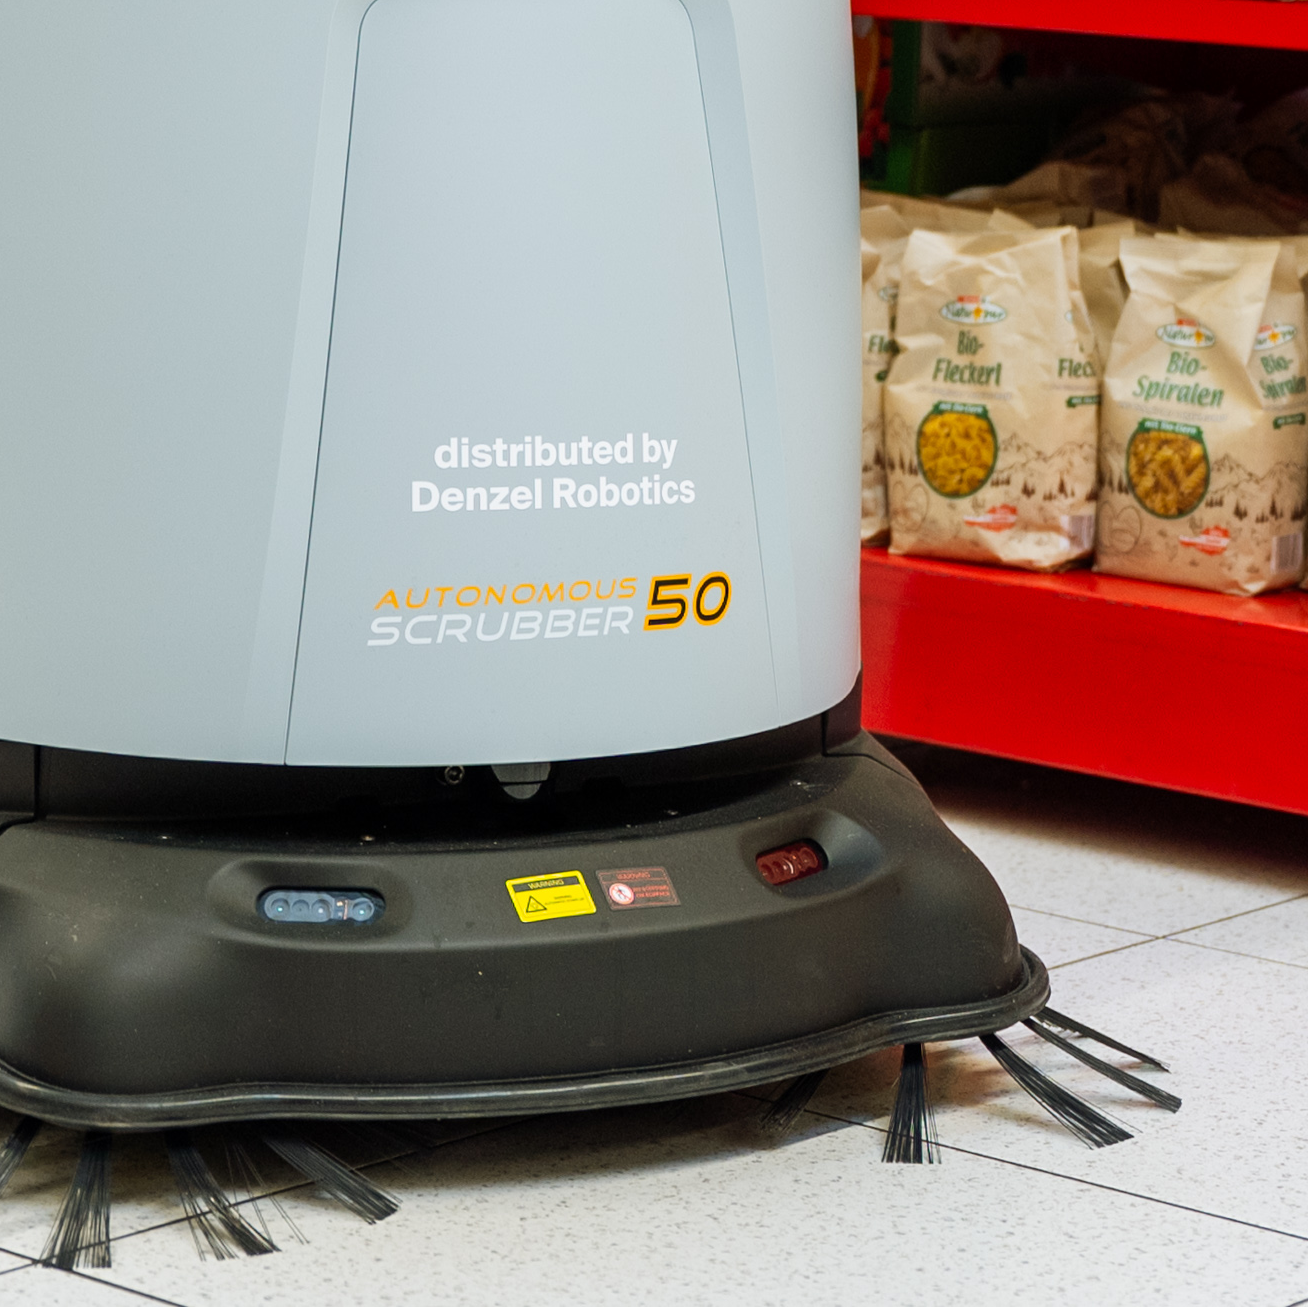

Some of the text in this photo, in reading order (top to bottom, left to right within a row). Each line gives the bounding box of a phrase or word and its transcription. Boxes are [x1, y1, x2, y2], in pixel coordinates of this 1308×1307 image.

[956, 329, 984, 356] Bio-
[932, 357, 1003, 386] Fleckerl
[1166, 350, 1208, 376] Bio-
[1132, 373, 1225, 408] Spiralen
[434, 432, 679, 470] distributed by
[411, 474, 697, 513] Denzel Robotics
[366, 570, 733, 647] SCRUBBER 50
[374, 576, 638, 612] AUTONOMOUS
[528, 878, 565, 890] WARNING
